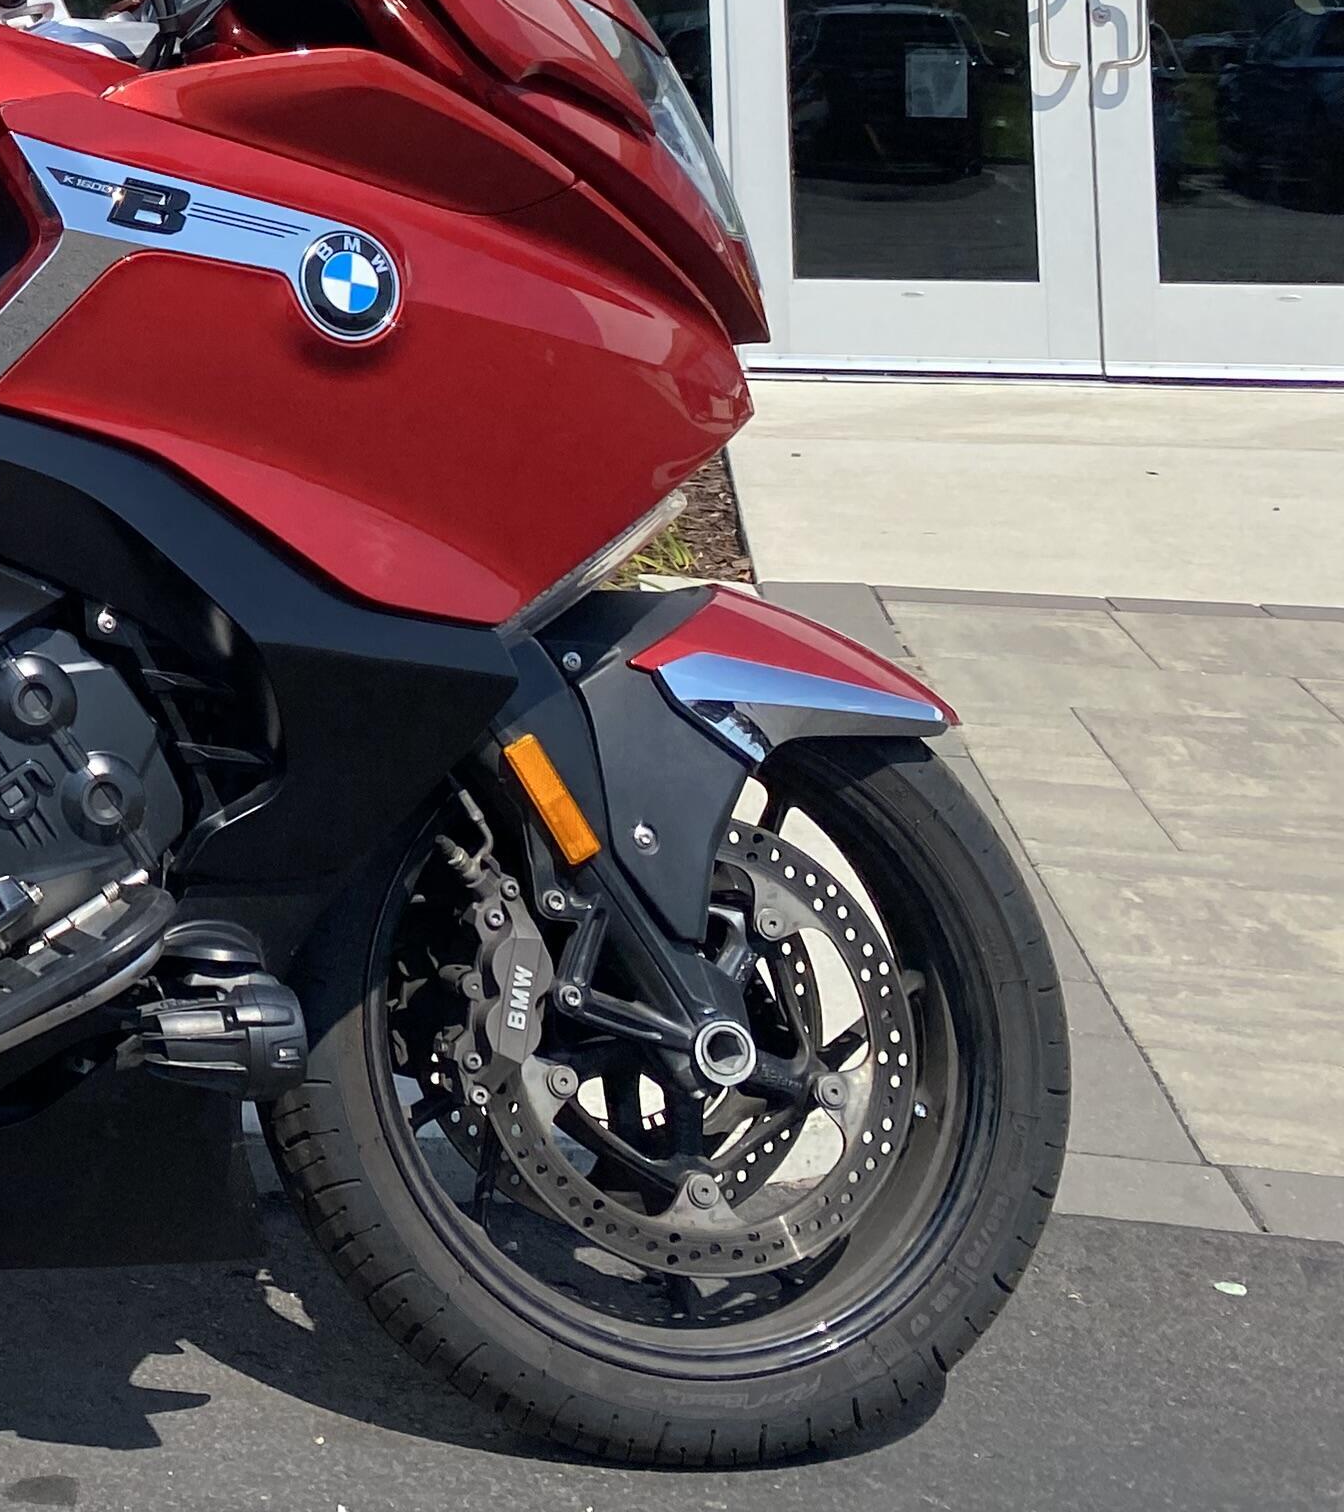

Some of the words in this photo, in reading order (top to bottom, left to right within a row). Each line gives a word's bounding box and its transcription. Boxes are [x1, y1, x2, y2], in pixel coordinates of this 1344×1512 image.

[62, 174, 75, 185] K
[106, 176, 191, 236] B
[506, 964, 534, 1031] BMW
